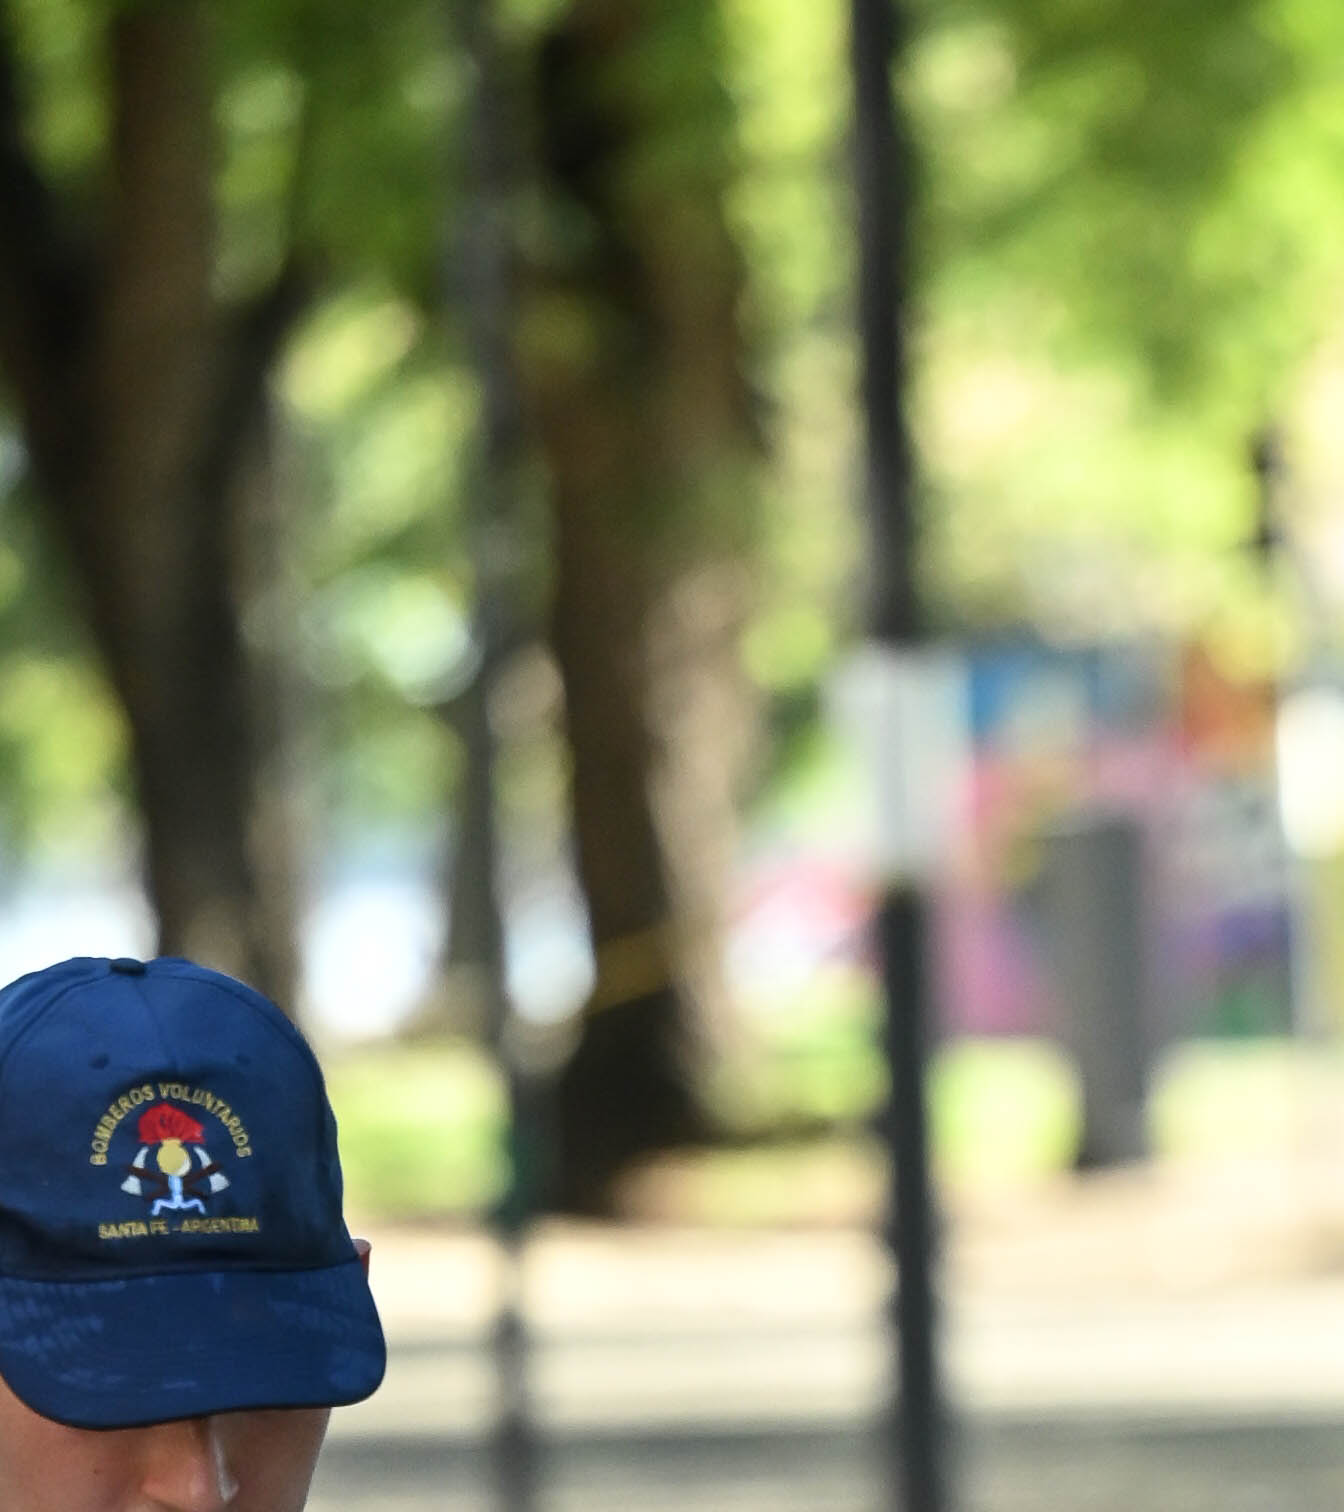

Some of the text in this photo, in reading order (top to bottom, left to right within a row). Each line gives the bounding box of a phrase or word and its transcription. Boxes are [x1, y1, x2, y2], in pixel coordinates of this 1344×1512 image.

[89, 1082, 253, 1166] BOMBEROS VOLUNTARIOS
[98, 1221, 148, 1239] SANTA
[150, 1220, 169, 1235] FE
